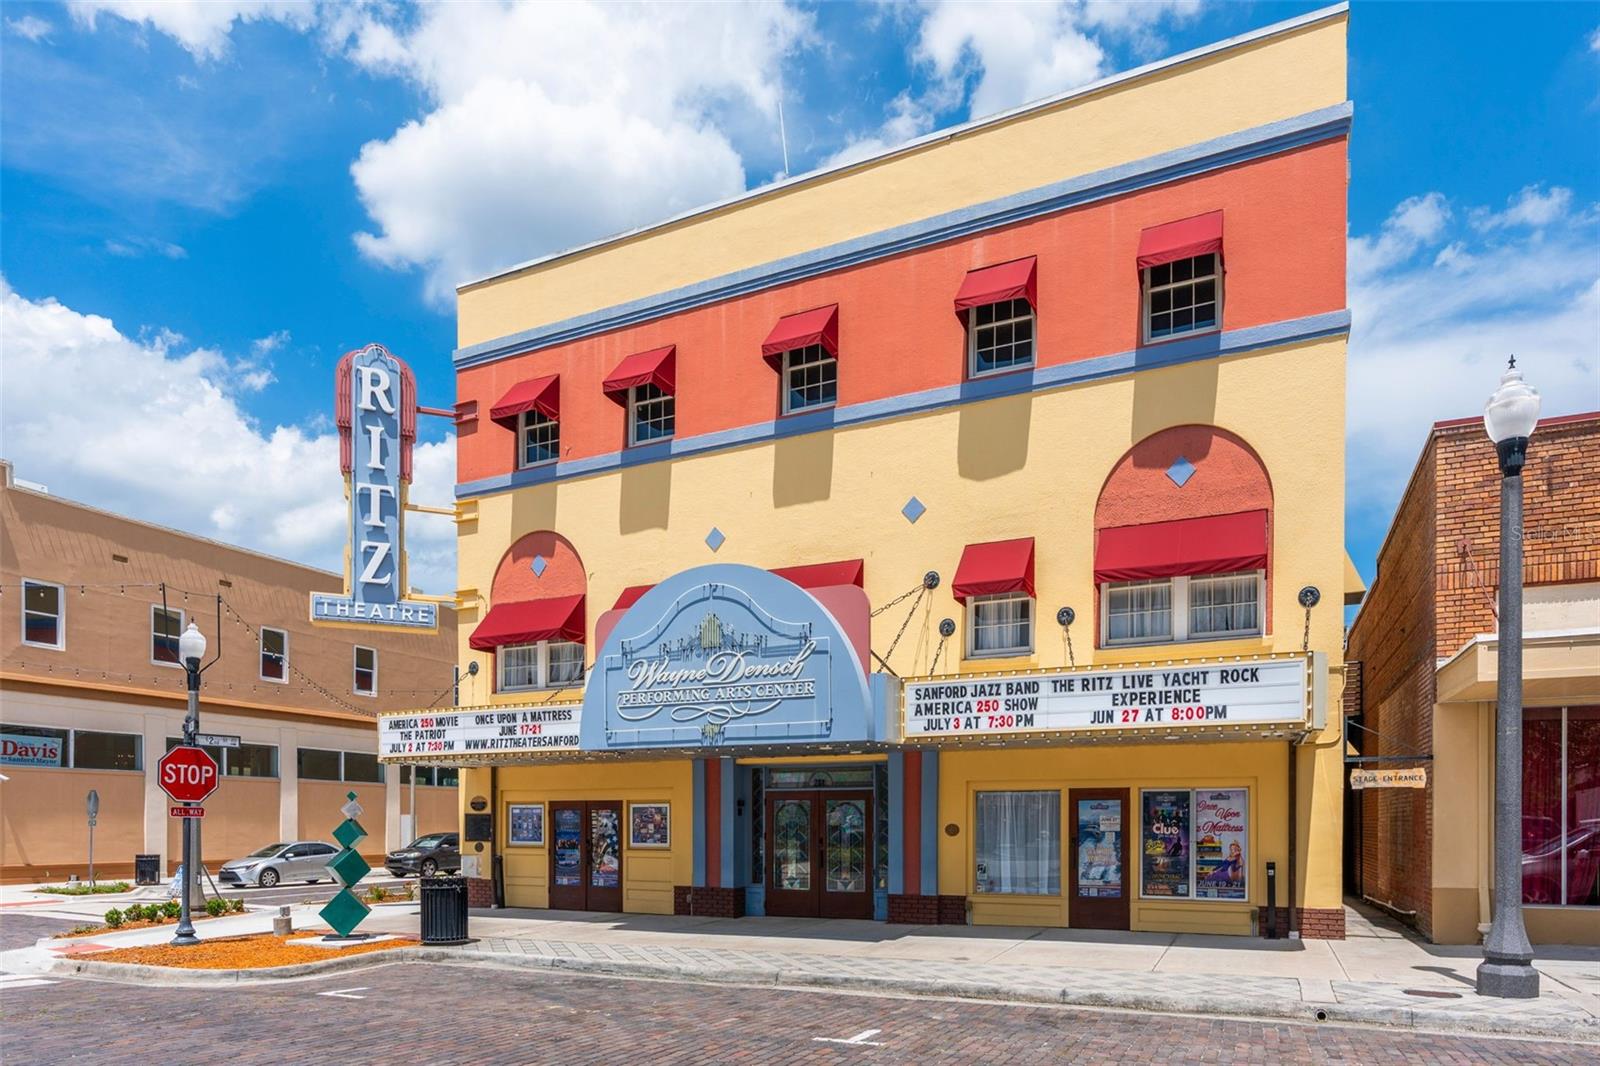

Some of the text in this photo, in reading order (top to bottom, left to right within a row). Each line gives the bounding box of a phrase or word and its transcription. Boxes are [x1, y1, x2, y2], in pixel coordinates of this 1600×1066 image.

[357, 365, 396, 587] RITZ
[320, 600, 430, 623] THEATRE
[628, 640, 816, 690] Wayne Densch
[1051, 668, 1260, 693] THE RITZ LIVE YACHT ROCK
[621, 681, 815, 706] PERFORMING ARTS CENTER
[915, 681, 1039, 701] SANFORD JAZZ BAND
[1111, 688, 1201, 707] EXPERIENCE
[914, 697, 1038, 717] AMERICA 250 SHOW
[1090, 705, 1227, 724] JUN 27 AT 8:00PM
[388, 716, 459, 731] AMERICA 250 MOVIE
[475, 710, 572, 725] ONCE UPON A MATTRESS
[923, 718, 951, 732] JULY
[953, 717, 961, 729] 3
[964, 716, 981, 730] AT
[400, 728, 446, 741] THE PATRIOT
[499, 724, 542, 737] JUNE 17-21
[1, 739, 58, 759] Davis
[389, 742, 406, 754] JULY
[407, 744, 413, 752] 2
[415, 741, 426, 751] AT
[465, 735, 580, 751] WWW.RITZTHEATERSANFORD
[164, 763, 214, 785] STOP
[1353, 774, 1425, 783] STAGE ENTRANCE
[172, 807, 204, 816] ALL WAY
